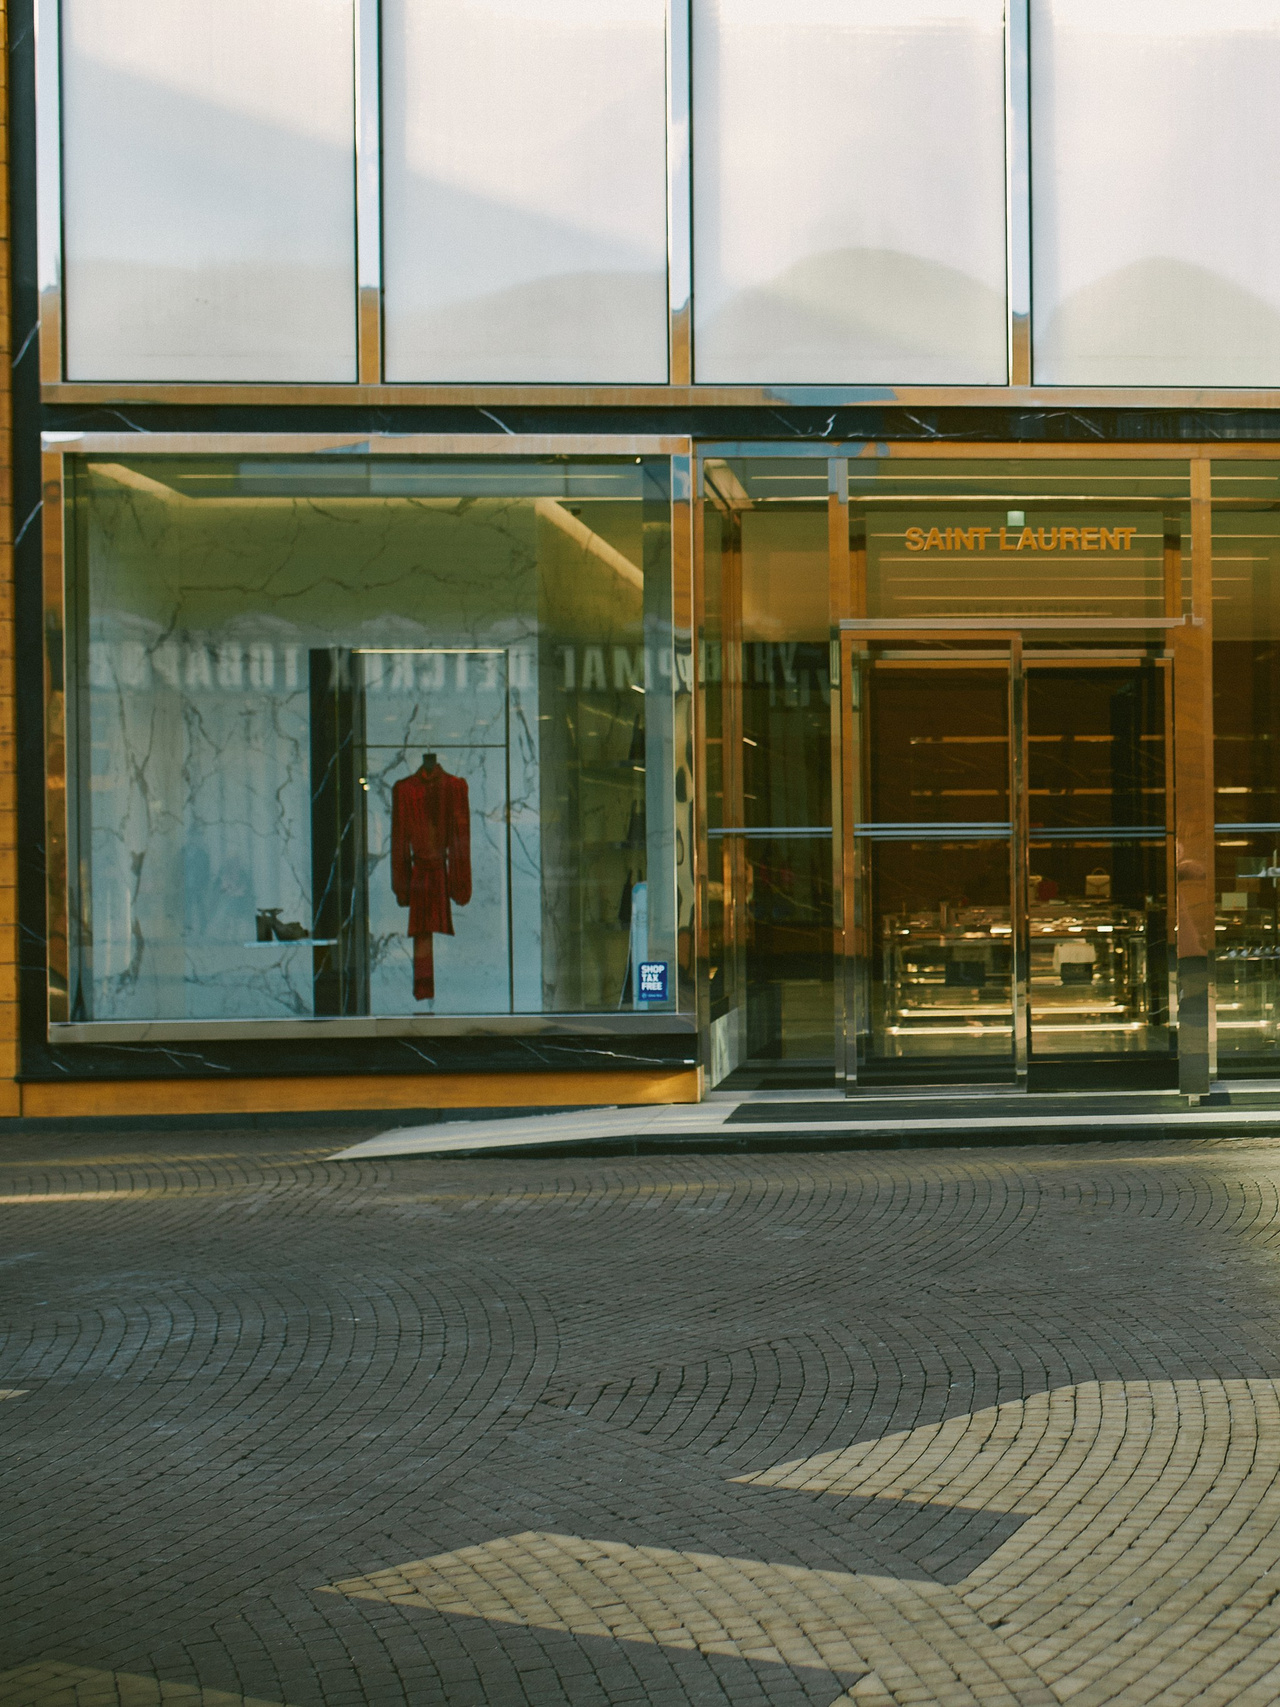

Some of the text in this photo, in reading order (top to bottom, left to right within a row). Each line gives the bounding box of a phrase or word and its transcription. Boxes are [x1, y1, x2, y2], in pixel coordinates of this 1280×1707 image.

[904, 527, 1137, 551] SAINT LAURENT
[641, 965, 665, 973] SHOP
[641, 973, 659, 982] TAX
[641, 982, 663, 990] FREE
